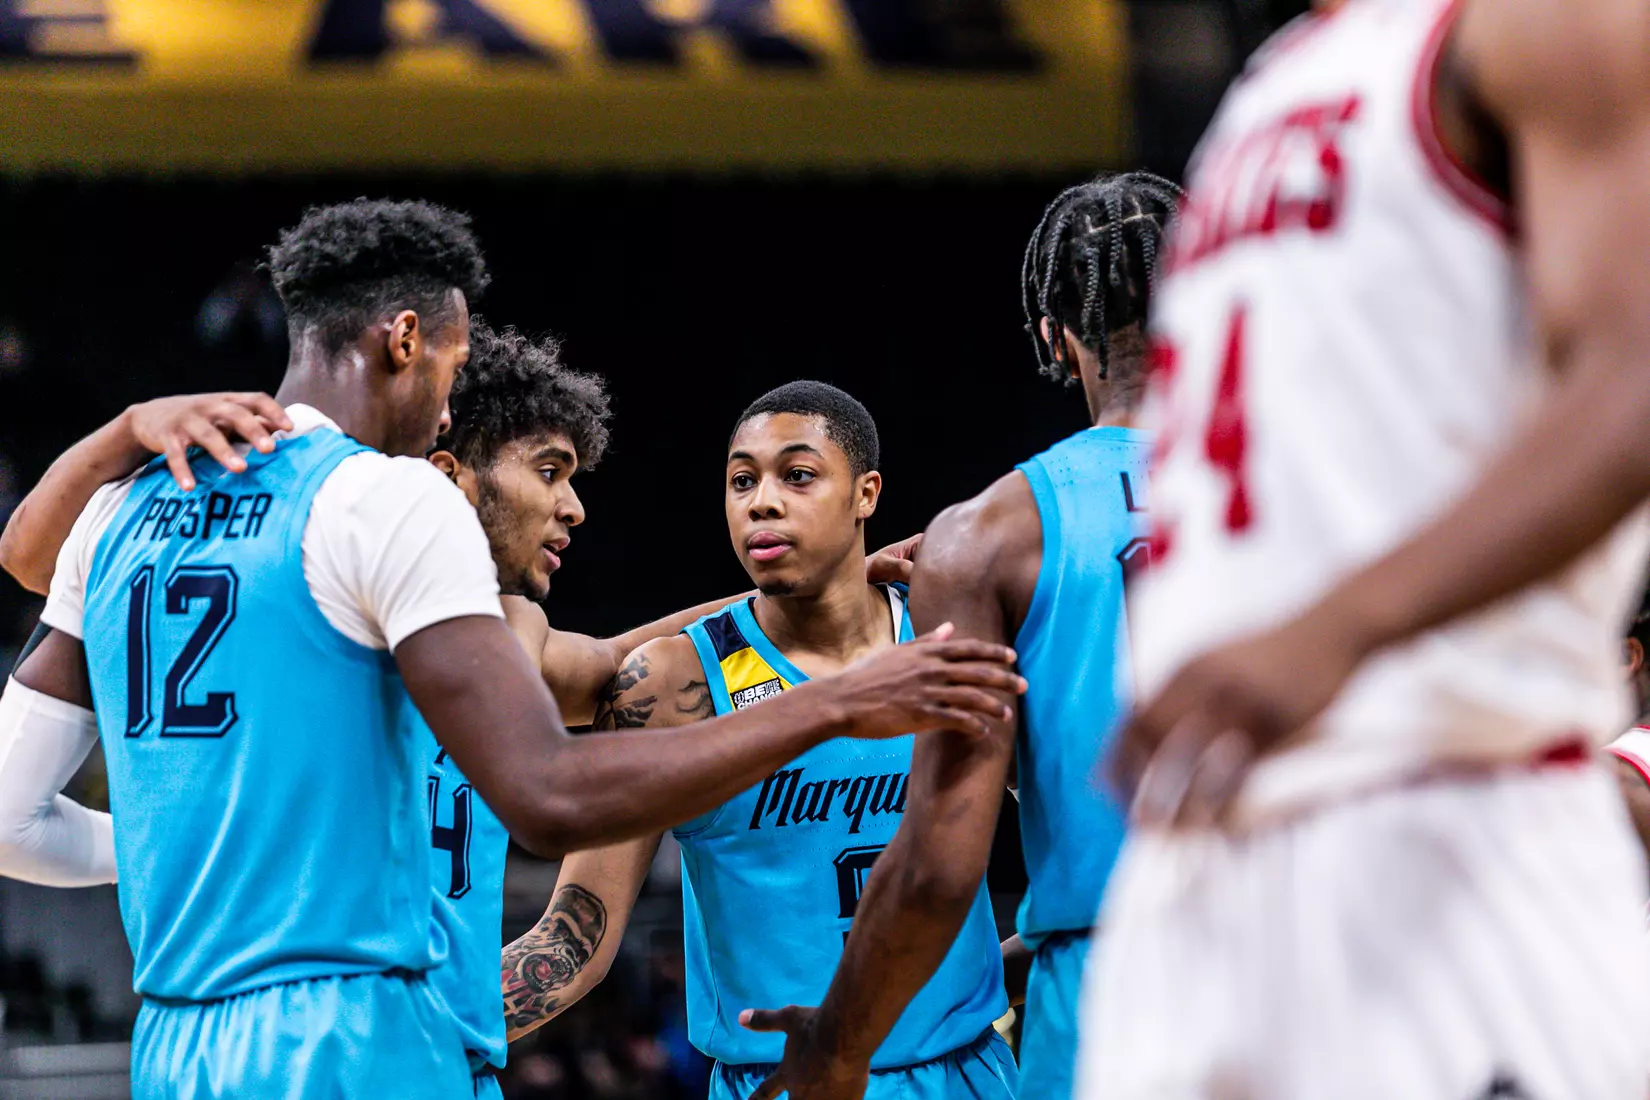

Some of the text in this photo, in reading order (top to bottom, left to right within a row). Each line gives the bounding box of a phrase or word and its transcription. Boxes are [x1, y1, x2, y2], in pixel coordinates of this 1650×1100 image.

[124, 564, 239, 738] 12
[743, 684, 766, 701] BE
[428, 776, 472, 900] 4
